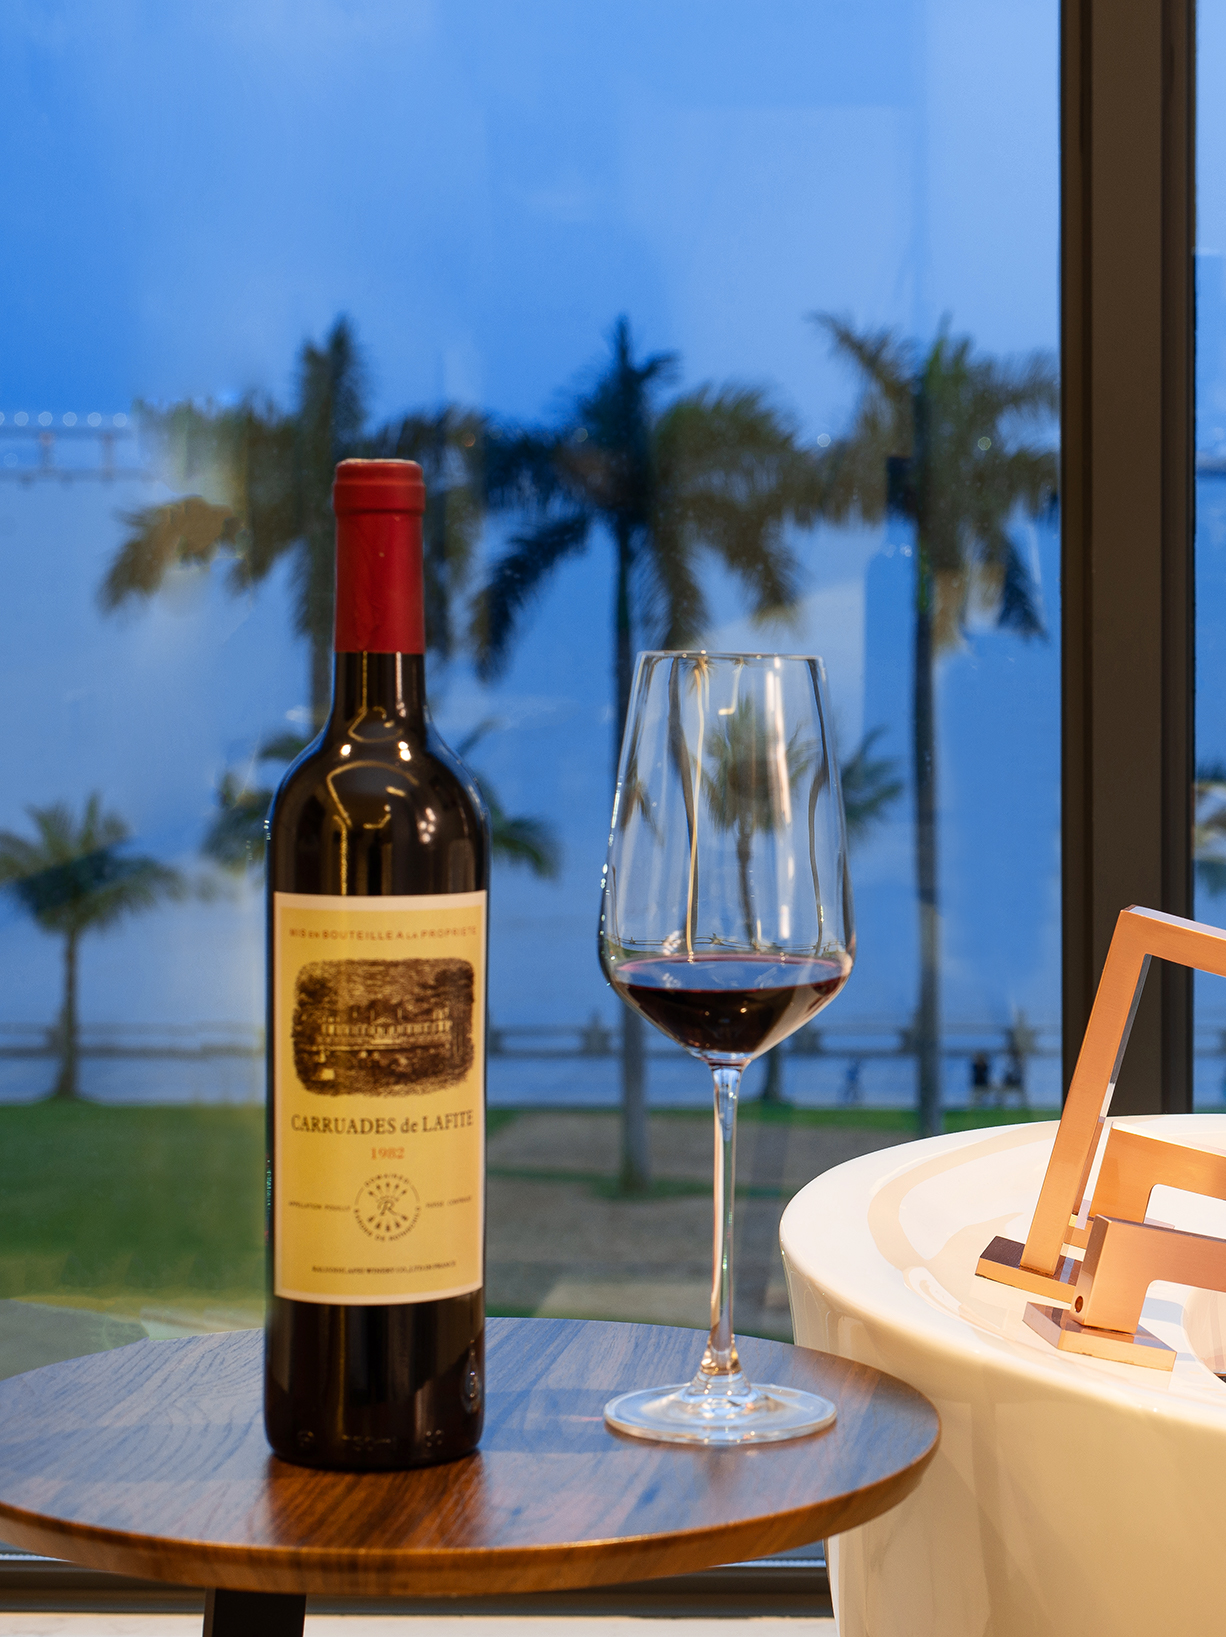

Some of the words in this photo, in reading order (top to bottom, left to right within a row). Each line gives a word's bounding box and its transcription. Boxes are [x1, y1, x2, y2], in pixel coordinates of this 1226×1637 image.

[289, 927, 307, 939] MIS
[322, 928, 394, 941] BOUTEILLE
[291, 1113, 397, 1135] CARRUADES
[400, 1116, 419, 1134] de
[422, 1109, 475, 1133] LAFITE
[371, 1147, 405, 1161] 1982
